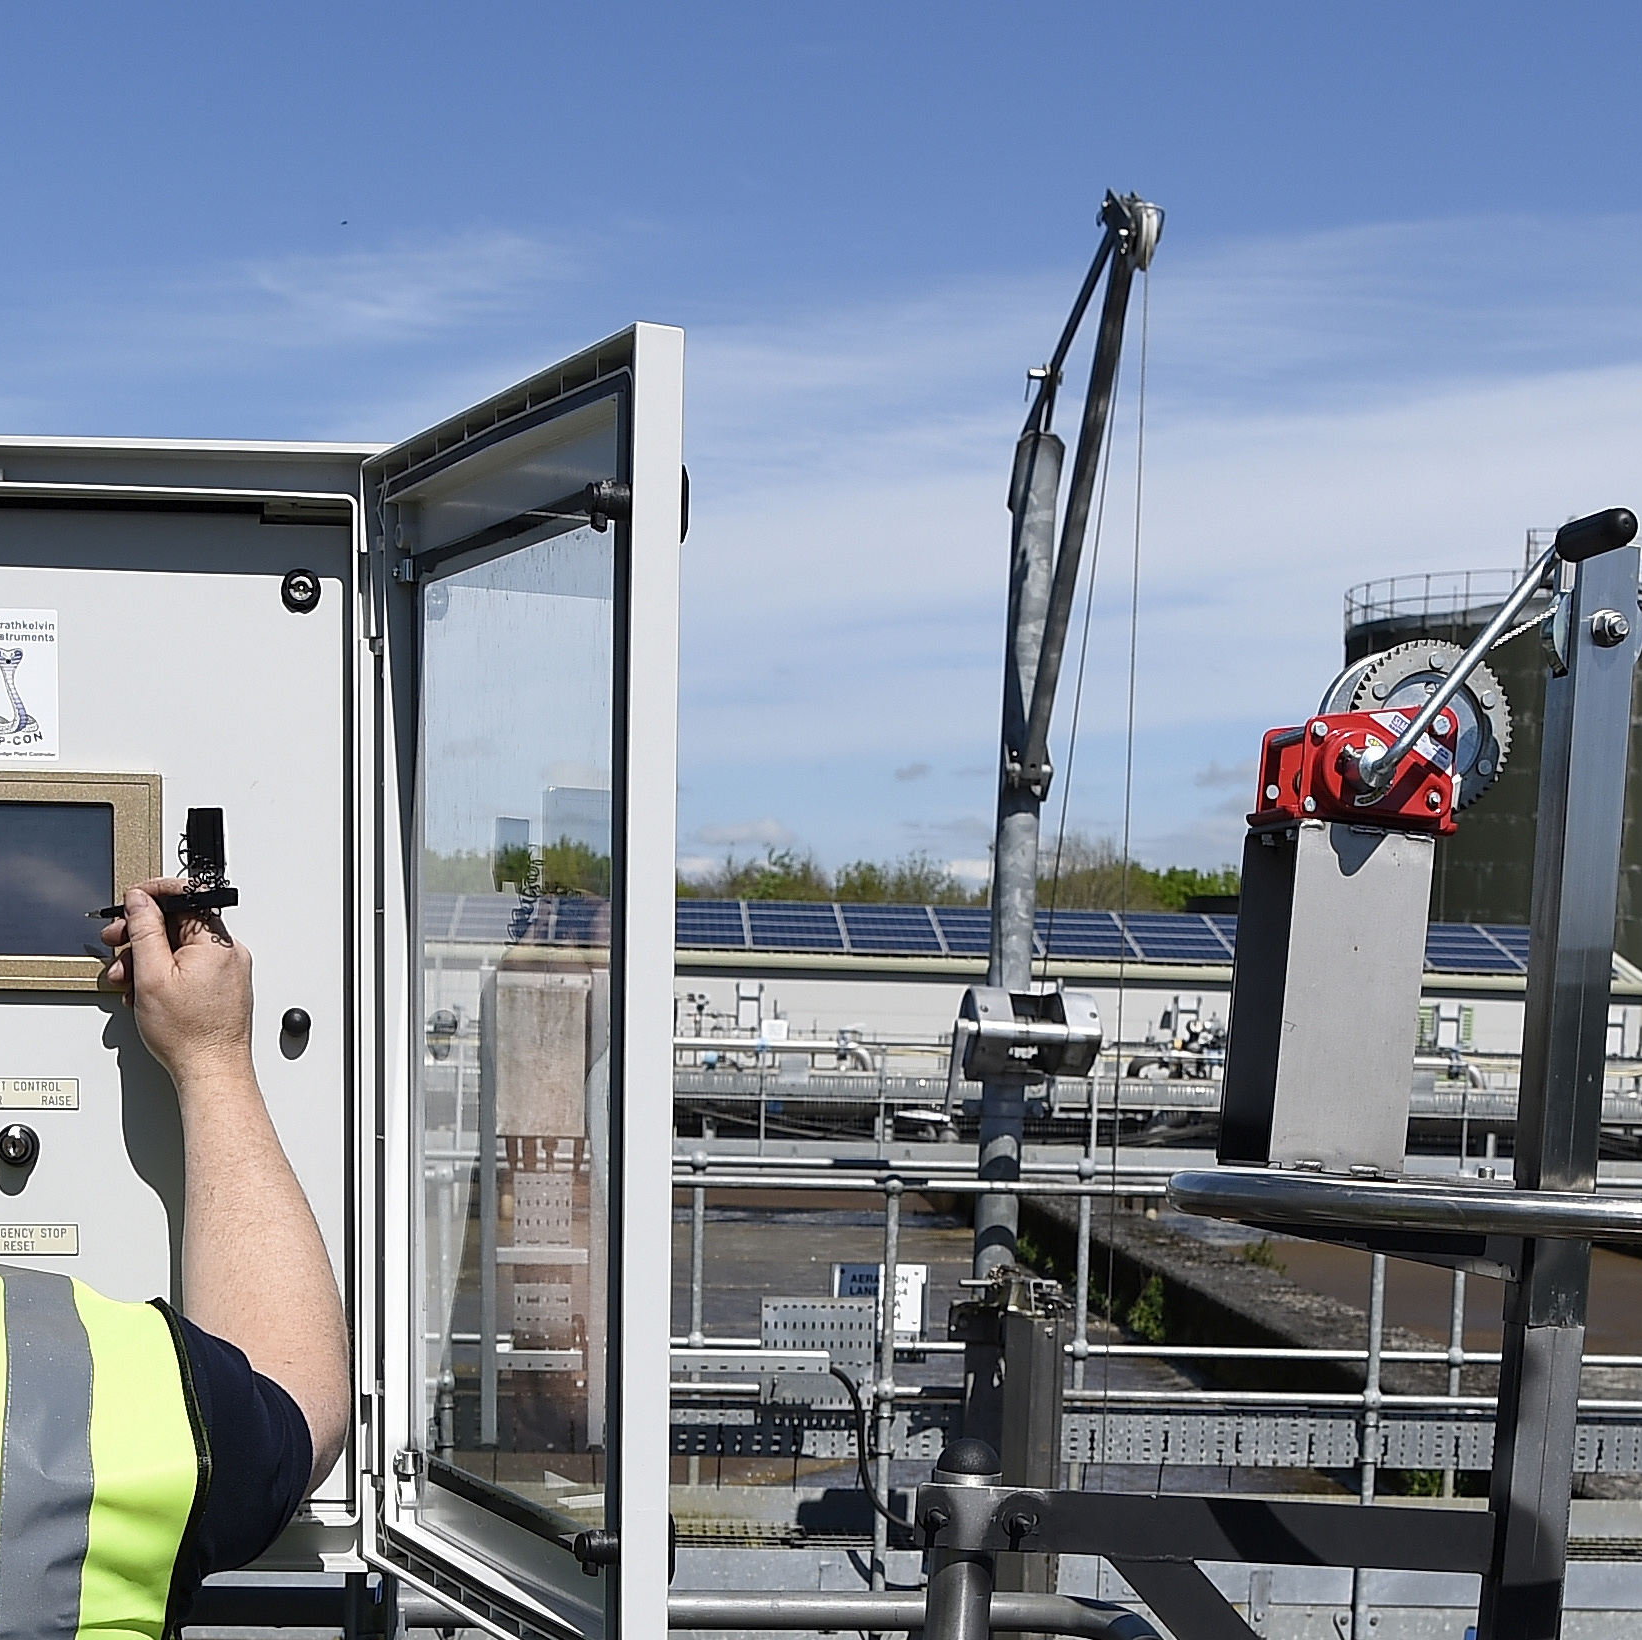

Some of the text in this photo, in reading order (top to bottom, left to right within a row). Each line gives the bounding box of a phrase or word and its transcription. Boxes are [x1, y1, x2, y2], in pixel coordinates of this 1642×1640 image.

[13, 1081, 61, 1092] CONTROL
[41, 1095, 72, 1106] RAISE
[40, 1228, 67, 1239] STOP
[3, 1241, 35, 1251] RESET
[850, 1273, 909, 1284] AERAON
